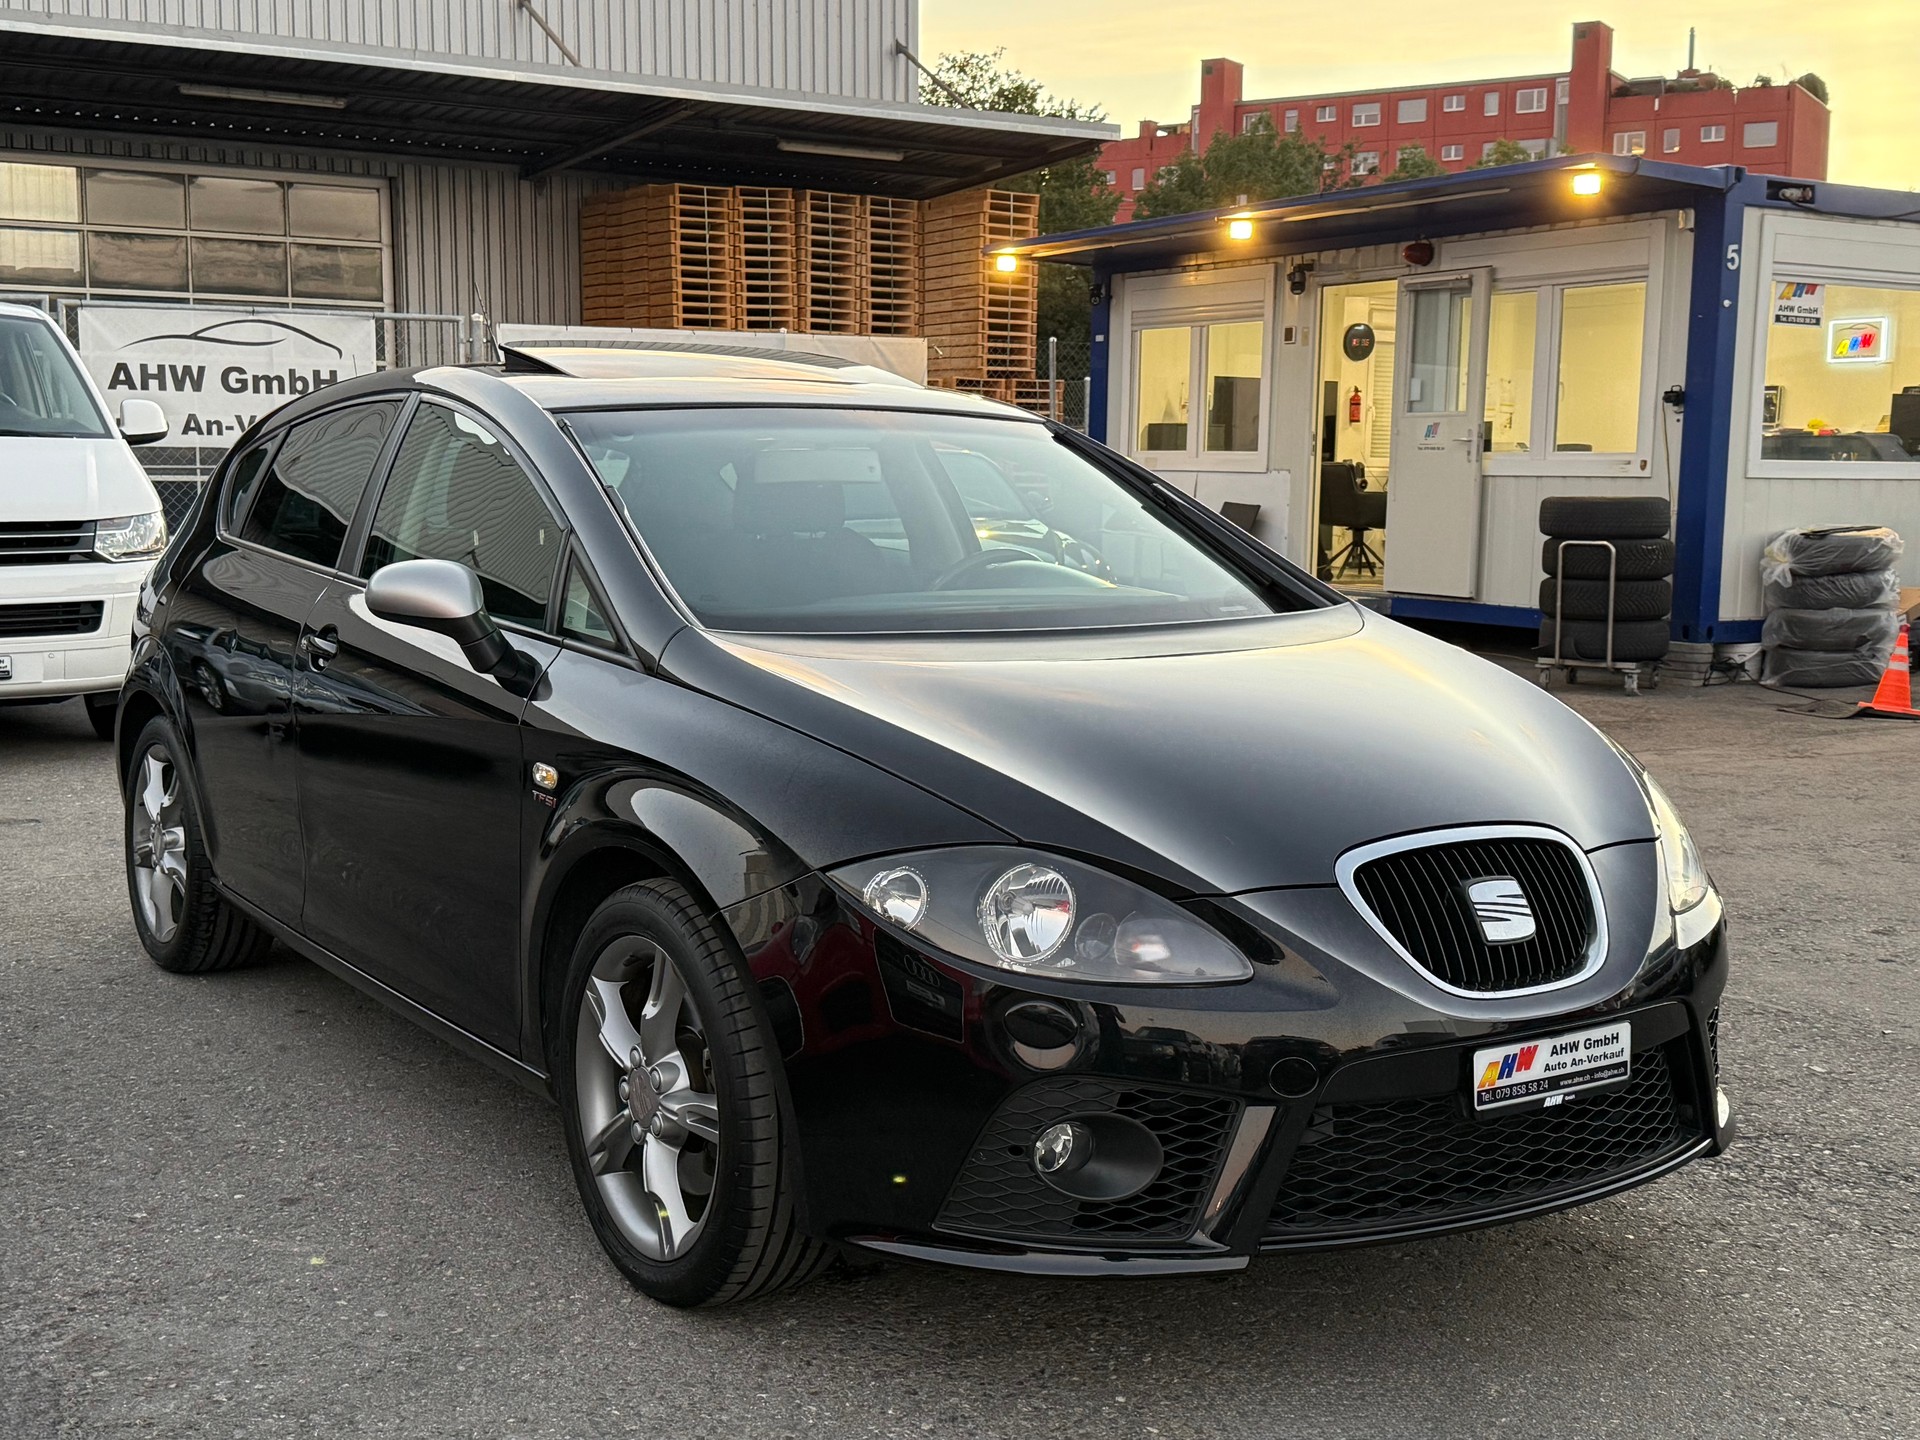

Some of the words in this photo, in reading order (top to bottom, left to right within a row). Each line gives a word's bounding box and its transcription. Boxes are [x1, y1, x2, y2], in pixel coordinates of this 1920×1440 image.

[1727, 244, 1739, 270] 5
[1778, 304, 1795, 313] AHW
[1797, 305, 1818, 315] GmbH
[1835, 333, 1876, 356] AHW
[108, 362, 206, 393] AHW
[221, 366, 337, 395] GmbH
[181, 413, 257, 436] An-V
[1550, 1039, 1580, 1058] AHW
[1583, 1032, 1619, 1050] GmbH
[1477, 1044, 1539, 1089] AHW
[1543, 1061, 1568, 1073] Auto
[1570, 1047, 1625, 1067] An-Verkauf
[1559, 1074, 1591, 1087] www.ahw.ch
[1594, 1067, 1625, 1079] info@ahw.ch
[1481, 1091, 1495, 1102] Tel.
[1495, 1086, 1511, 1099] 079
[1511, 1083, 1527, 1096] 858
[1528, 1081, 1538, 1093] 58
[1539, 1079, 1549, 1091] 24
[1543, 1094, 1564, 1108] AHW
